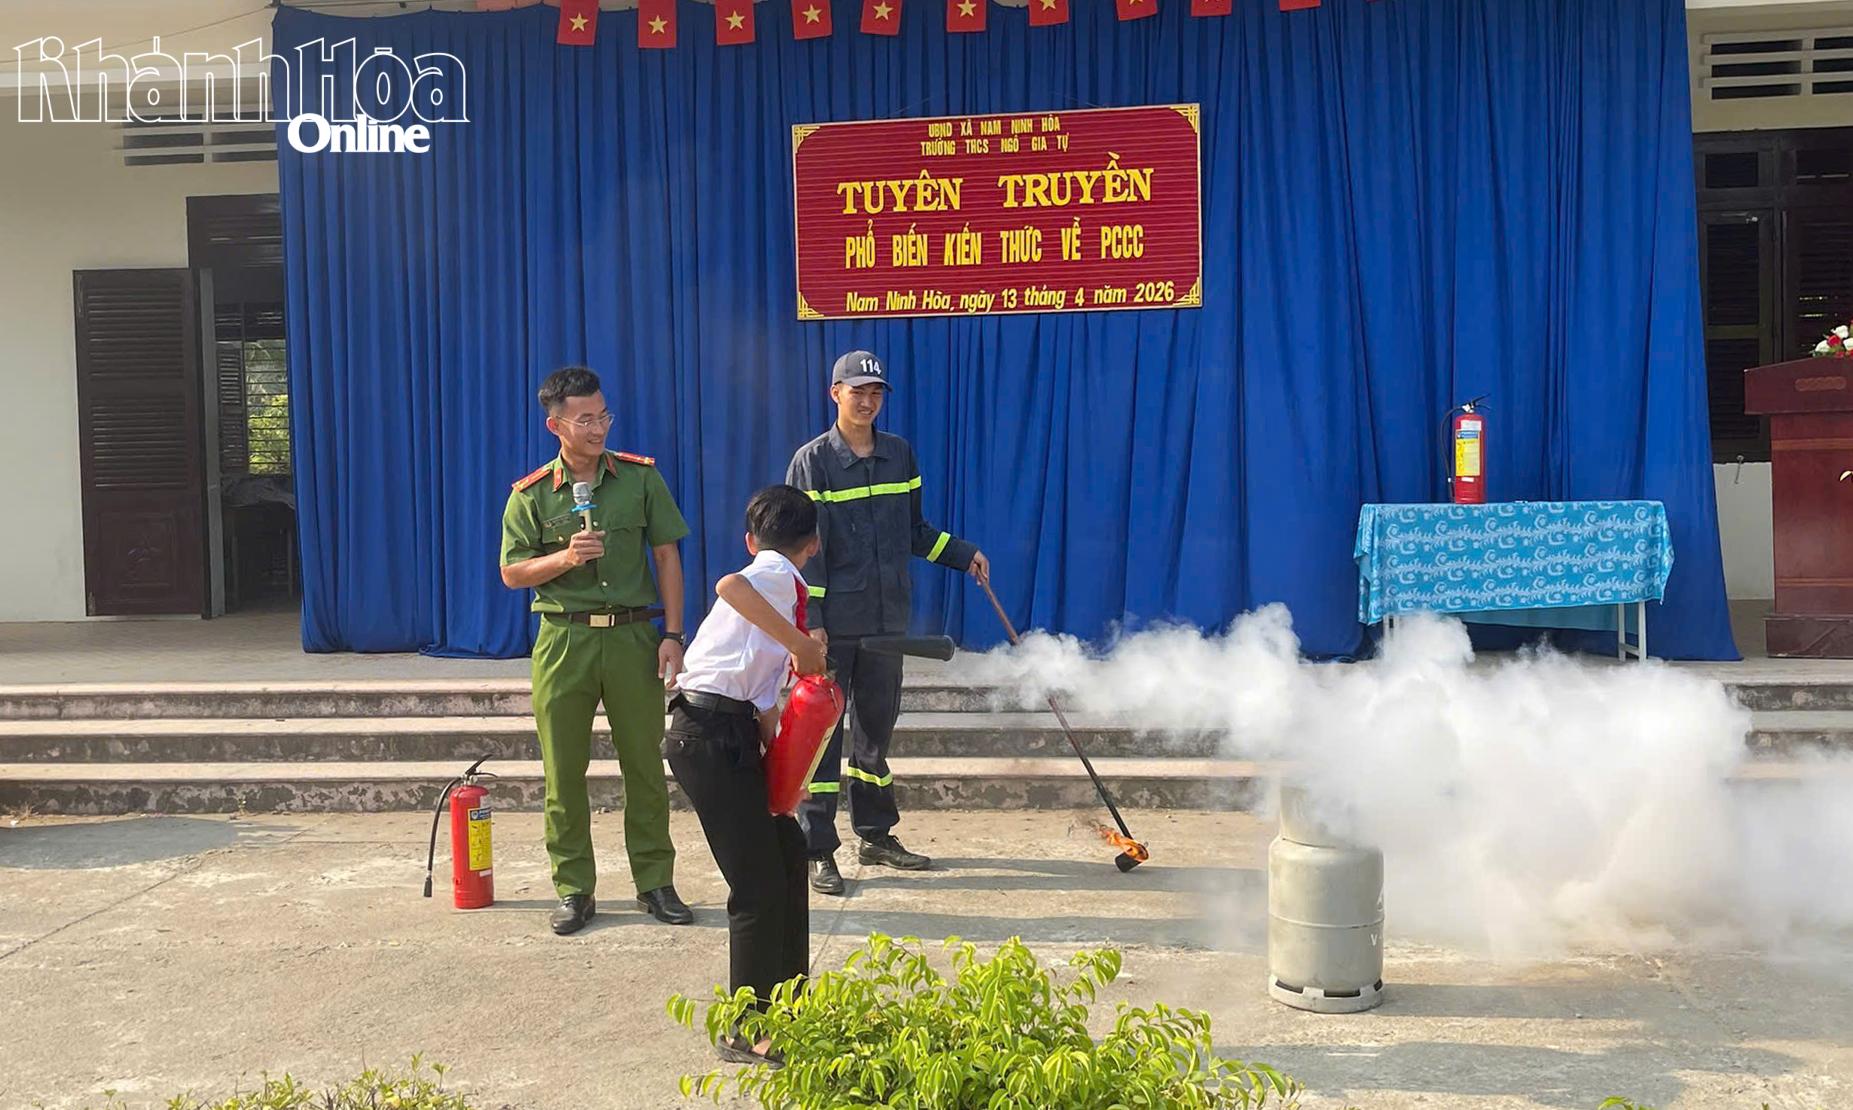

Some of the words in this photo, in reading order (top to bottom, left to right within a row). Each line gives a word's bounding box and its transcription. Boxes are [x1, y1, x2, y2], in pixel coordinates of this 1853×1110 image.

[928, 122, 953, 138] UBND
[980, 119, 1002, 136] NAM
[1011, 118, 1033, 134] NINH
[920, 138, 956, 156] TRƯỜNG
[965, 138, 989, 154] THCS
[1000, 134, 1020, 153] NGÔ
[1031, 136, 1048, 151] GIA
[836, 169, 964, 215] TUYÊN
[997, 151, 1155, 208] TRUYỀN
[845, 219, 876, 269] PHỔ
[892, 223, 928, 267] BIẾN
[943, 222, 982, 266] KIẾN
[1000, 225, 1042, 264] THỨC
[1061, 216, 1082, 261] VỀ
[1100, 224, 1144, 259] PCCC
[845, 291, 879, 312] Nam
[886, 290, 917, 311] Ninh
[921, 288, 955, 311] Hòa,
[959, 291, 995, 314] ngày
[1001, 288, 1018, 309] 13
[1024, 284, 1067, 309] tháng
[1075, 287, 1085, 307] 4
[1094, 284, 1127, 304] năm
[1134, 280, 1176, 303] 2026
[860, 359, 882, 375] 114
